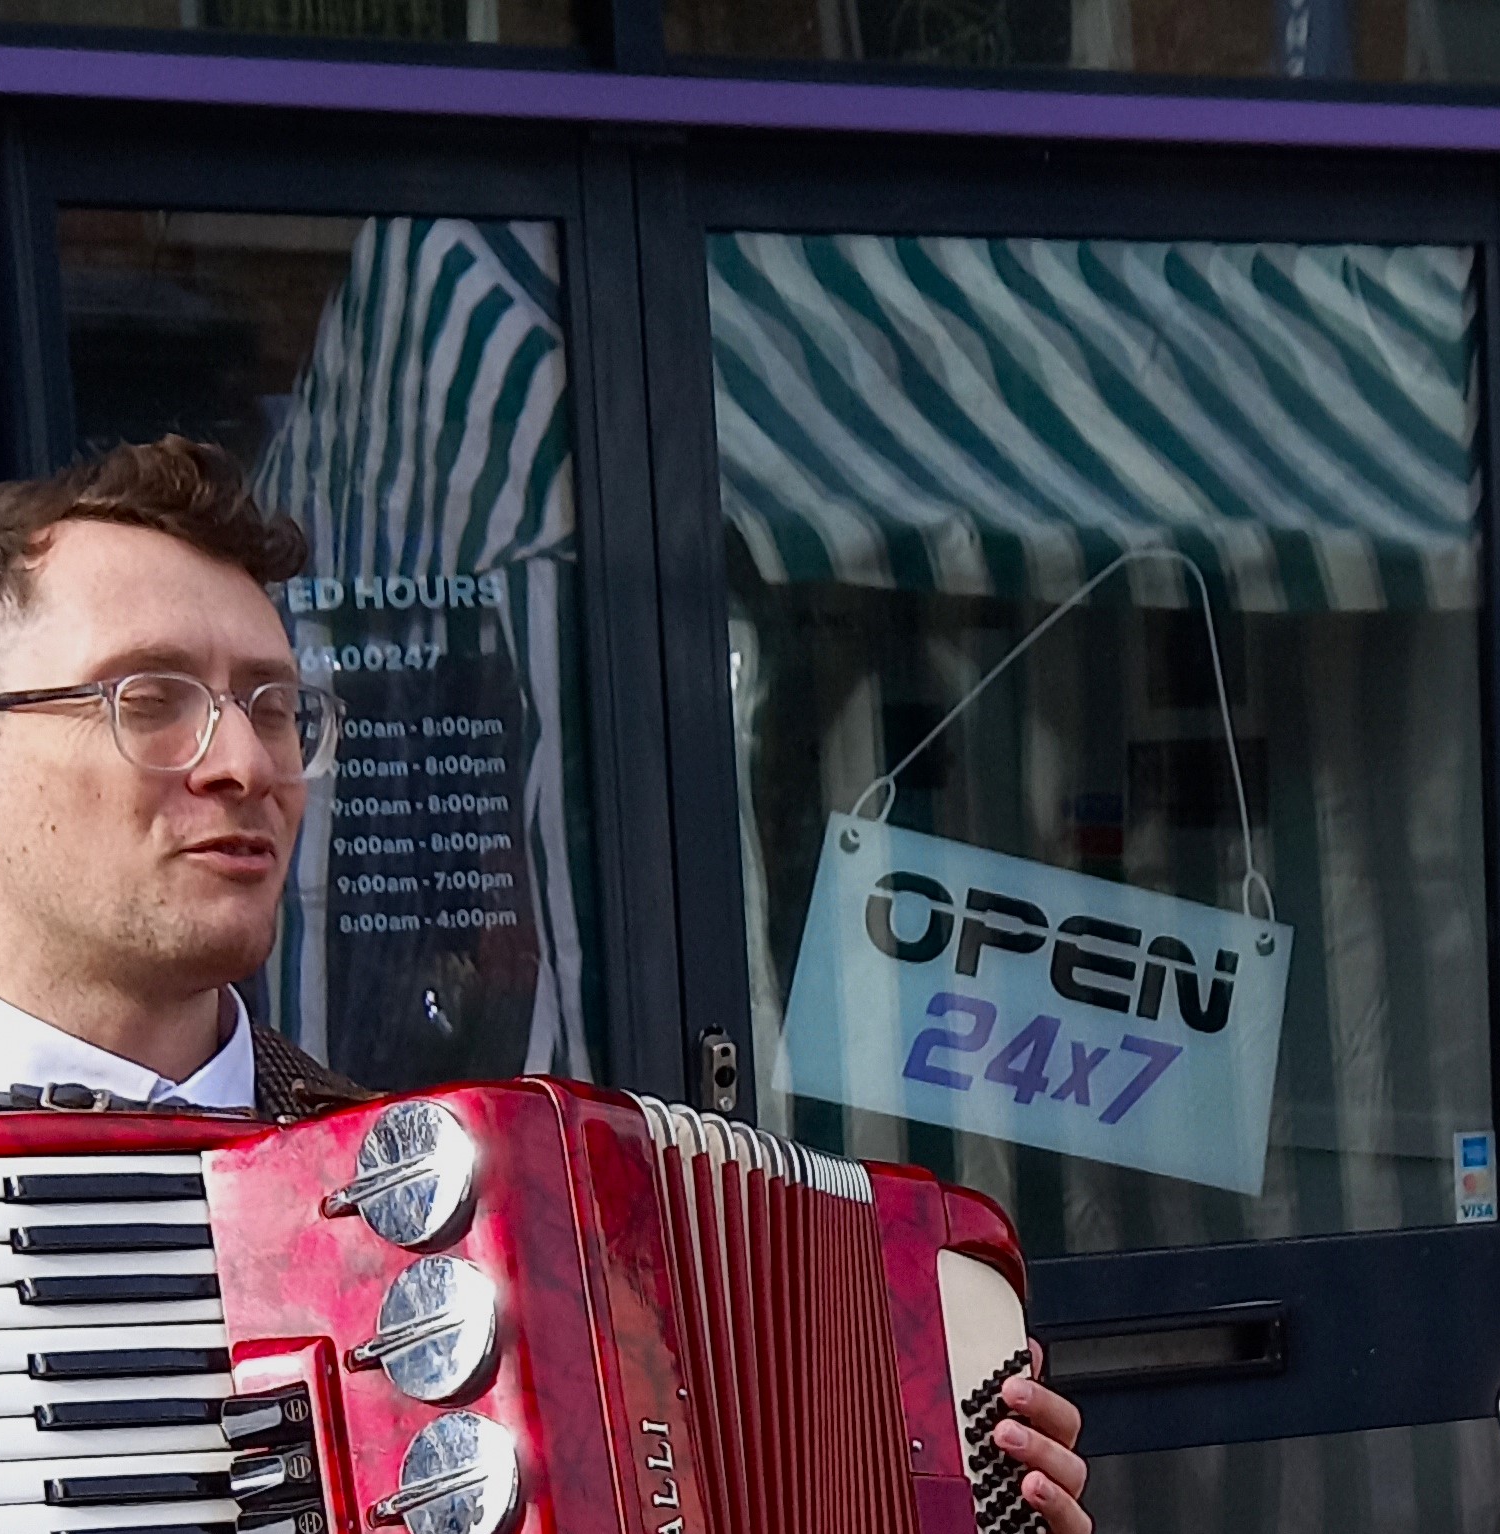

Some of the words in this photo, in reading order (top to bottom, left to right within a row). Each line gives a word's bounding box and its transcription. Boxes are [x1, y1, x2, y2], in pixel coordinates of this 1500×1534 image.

[353, 575, 503, 609] HOURS
[422, 715, 503, 740] 8:00pm
[425, 754, 506, 778] 8:00pm
[428, 793, 509, 817] 8:00pm
[333, 835, 415, 857] 9:00am
[431, 831, 512, 856] 8:00pm
[336, 873, 418, 896] 9:00am
[434, 870, 514, 895] 7:00pm
[339, 911, 421, 934] 8:00am
[436, 908, 518, 933] 4:00pm
[865, 871, 1240, 1034] OPEN
[902, 991, 1184, 1126] 24x7
[1460, 1203, 1493, 1219] VISA
